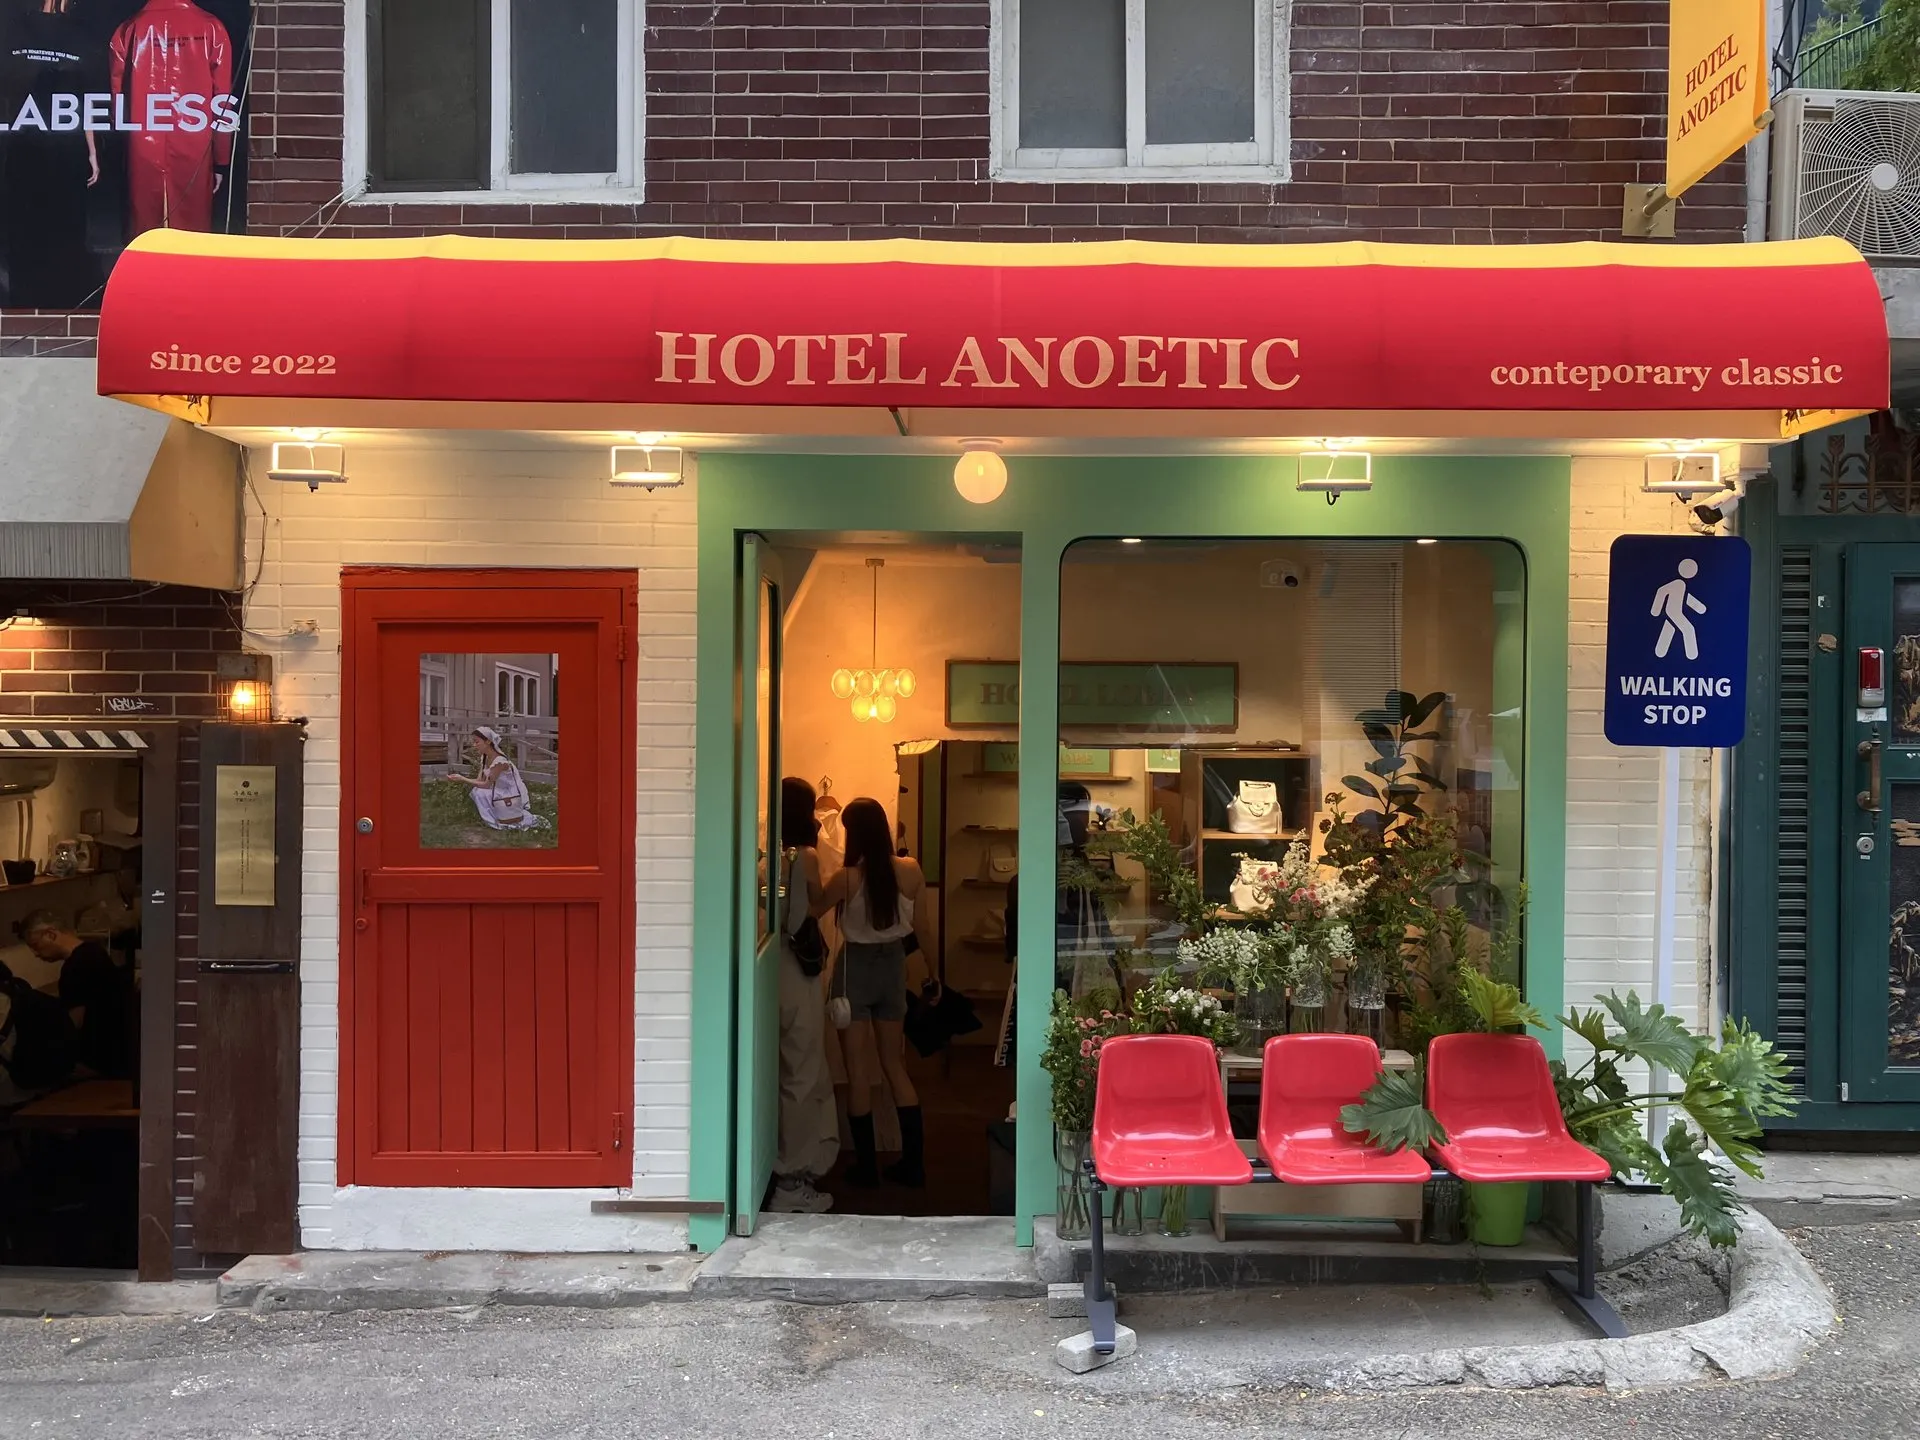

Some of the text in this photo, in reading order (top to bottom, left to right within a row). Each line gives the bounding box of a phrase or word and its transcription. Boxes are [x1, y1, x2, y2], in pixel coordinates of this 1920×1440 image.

[1685, 33, 1739, 98] HOTEL
[0, 93, 240, 132] ABELESS
[1676, 64, 1747, 142] ANOETIC
[150, 344, 337, 375] since 2022
[654, 331, 1302, 391] HOTEL ANOETIC
[1490, 356, 1844, 392] conteporary classic
[1620, 676, 1732, 725] WALKING STOP
